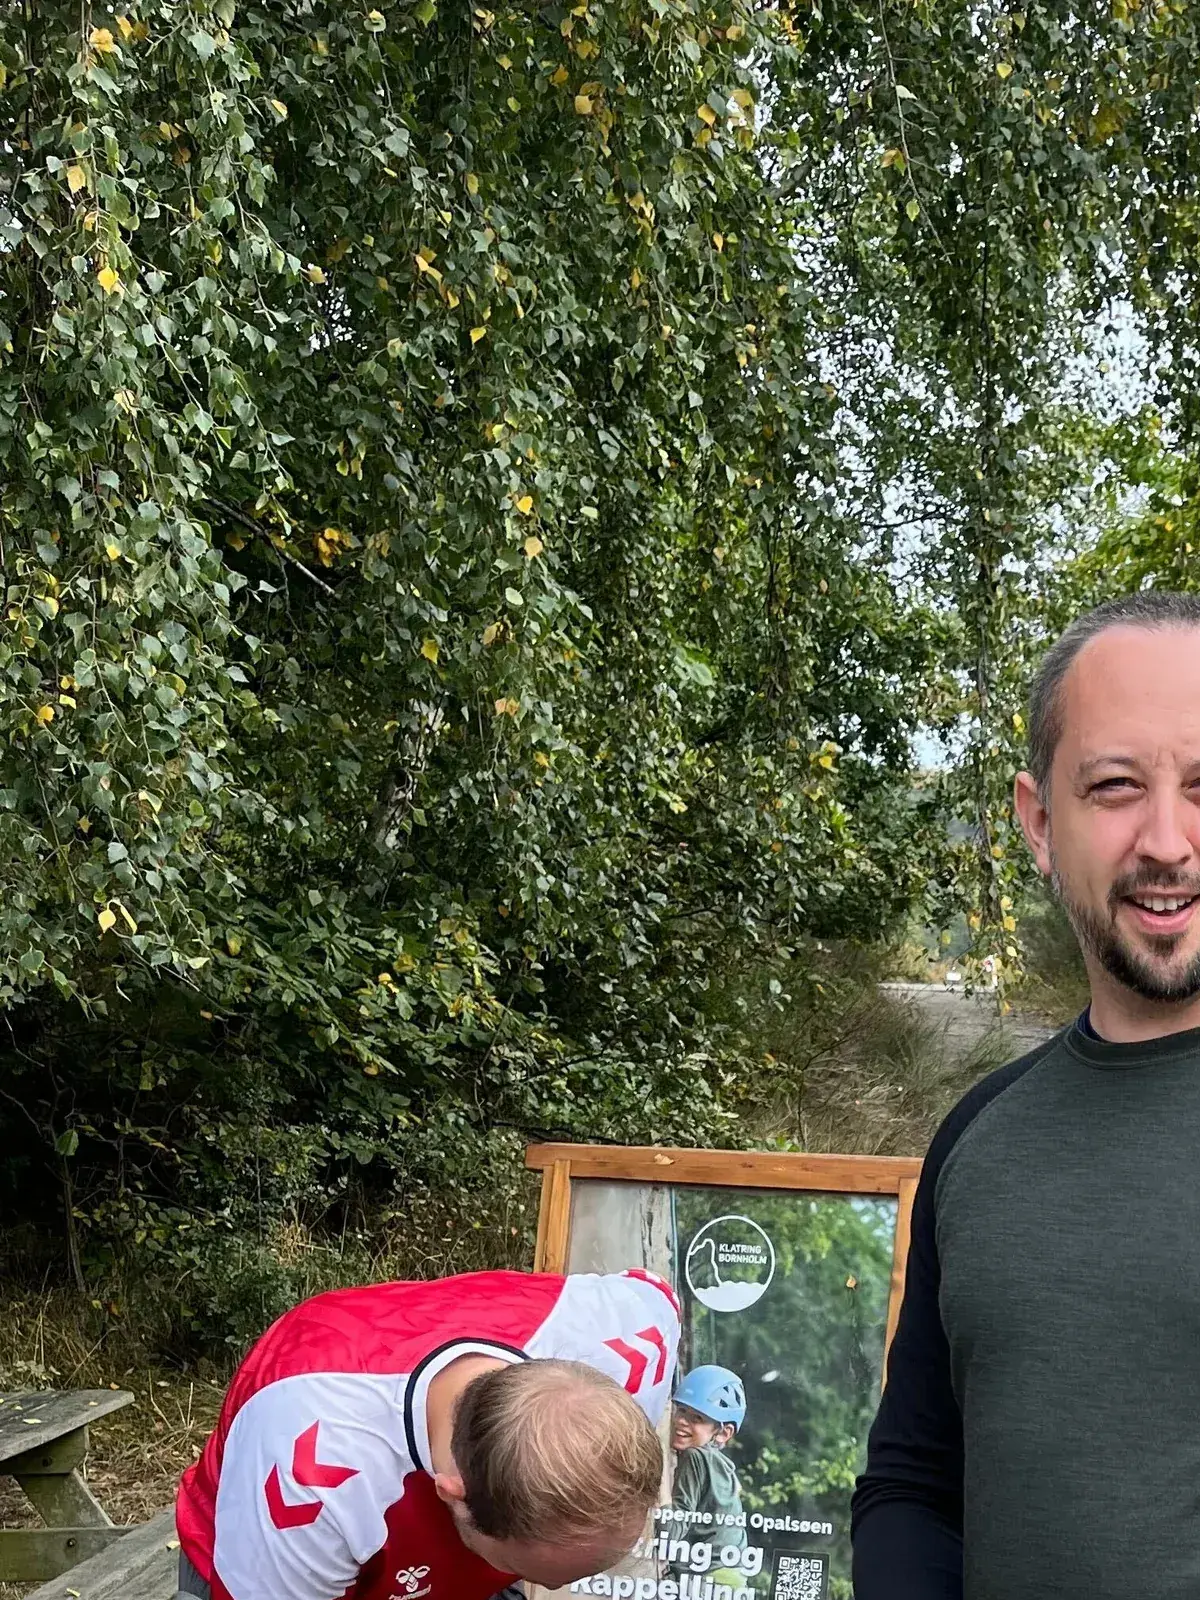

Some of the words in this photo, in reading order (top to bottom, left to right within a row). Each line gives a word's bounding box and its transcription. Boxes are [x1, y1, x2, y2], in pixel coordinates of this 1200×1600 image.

[719, 1244, 761, 1254] KLATRING
[718, 1253, 767, 1264] BORNHOLM
[715, 1511, 747, 1527] ved
[750, 1513, 832, 1534] Opalsøen
[720, 1545, 764, 1577] og
